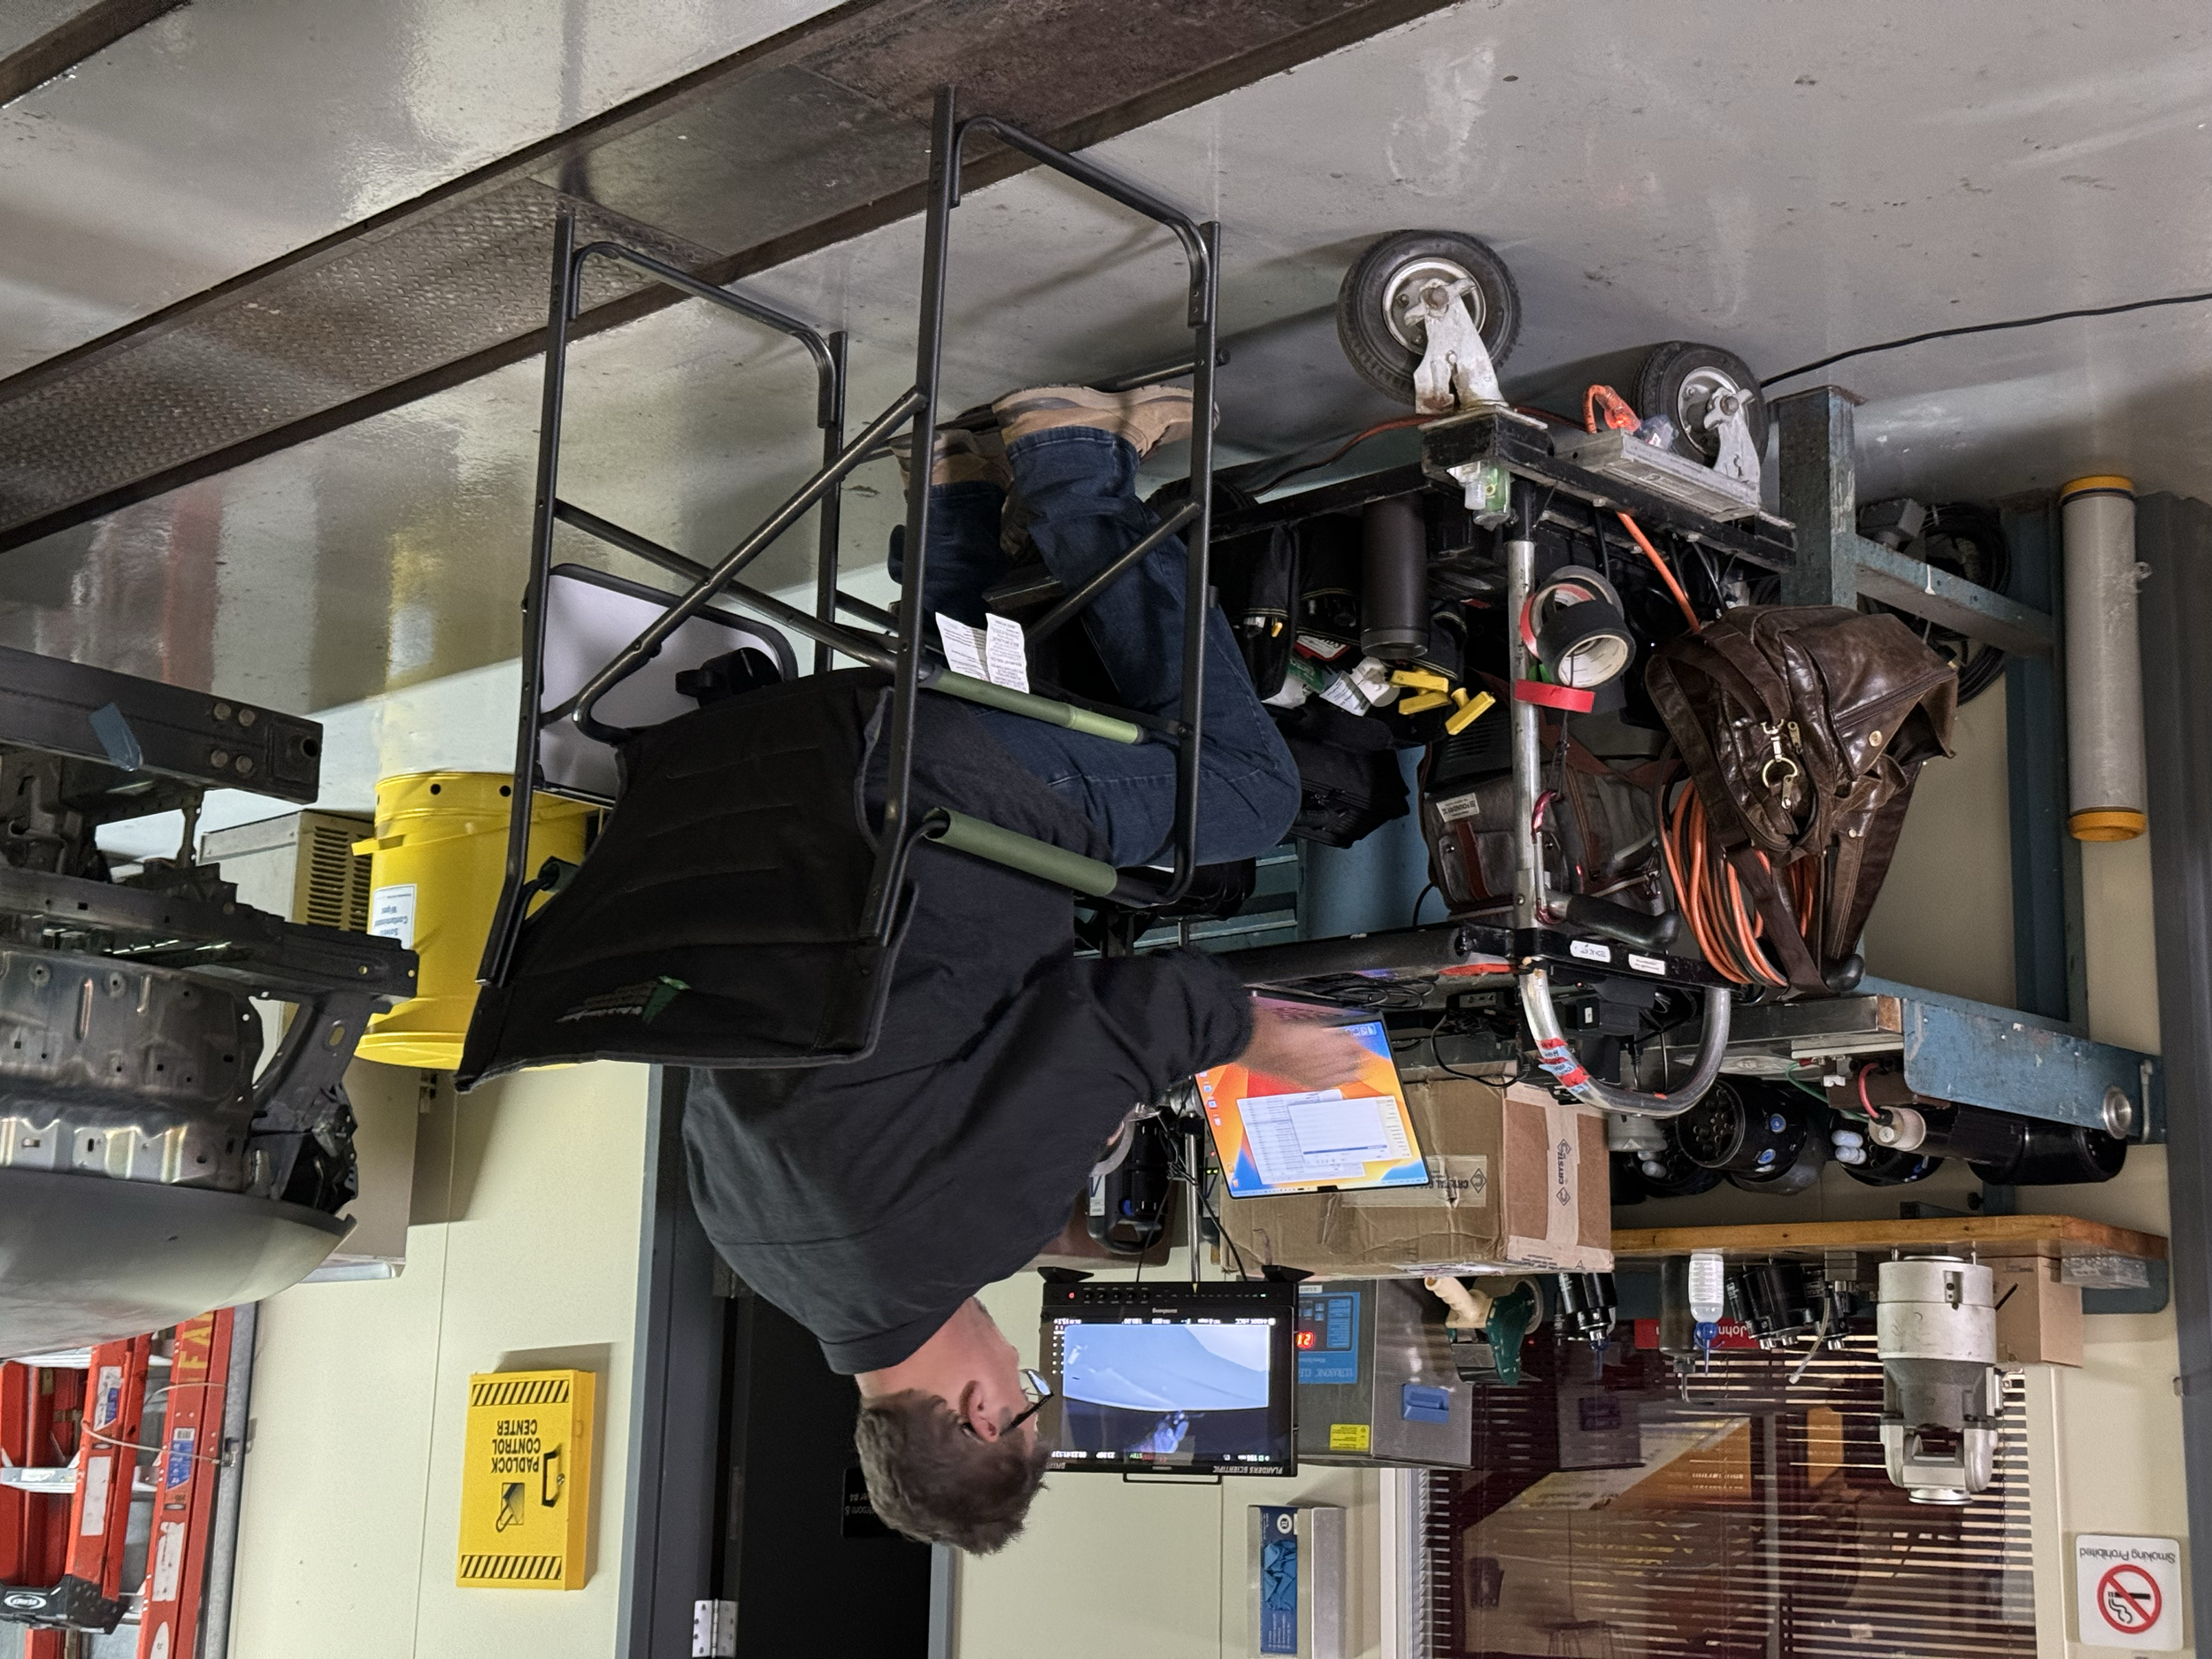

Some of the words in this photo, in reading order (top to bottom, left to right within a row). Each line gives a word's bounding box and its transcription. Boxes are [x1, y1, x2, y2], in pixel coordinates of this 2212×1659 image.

[1718, 1325, 1747, 1338] John
[496, 1419, 538, 1436] CENTER
[491, 1437, 541, 1455] CONTROL
[489, 1456, 540, 1474] PADLOCK
[1212, 1465, 1248, 1474] SCIENTIFIC
[1249, 1465, 1283, 1474] FLANDERS
[2079, 1547, 2129, 1560] Prohibited
[2131, 1548, 2176, 1563] Smoking
